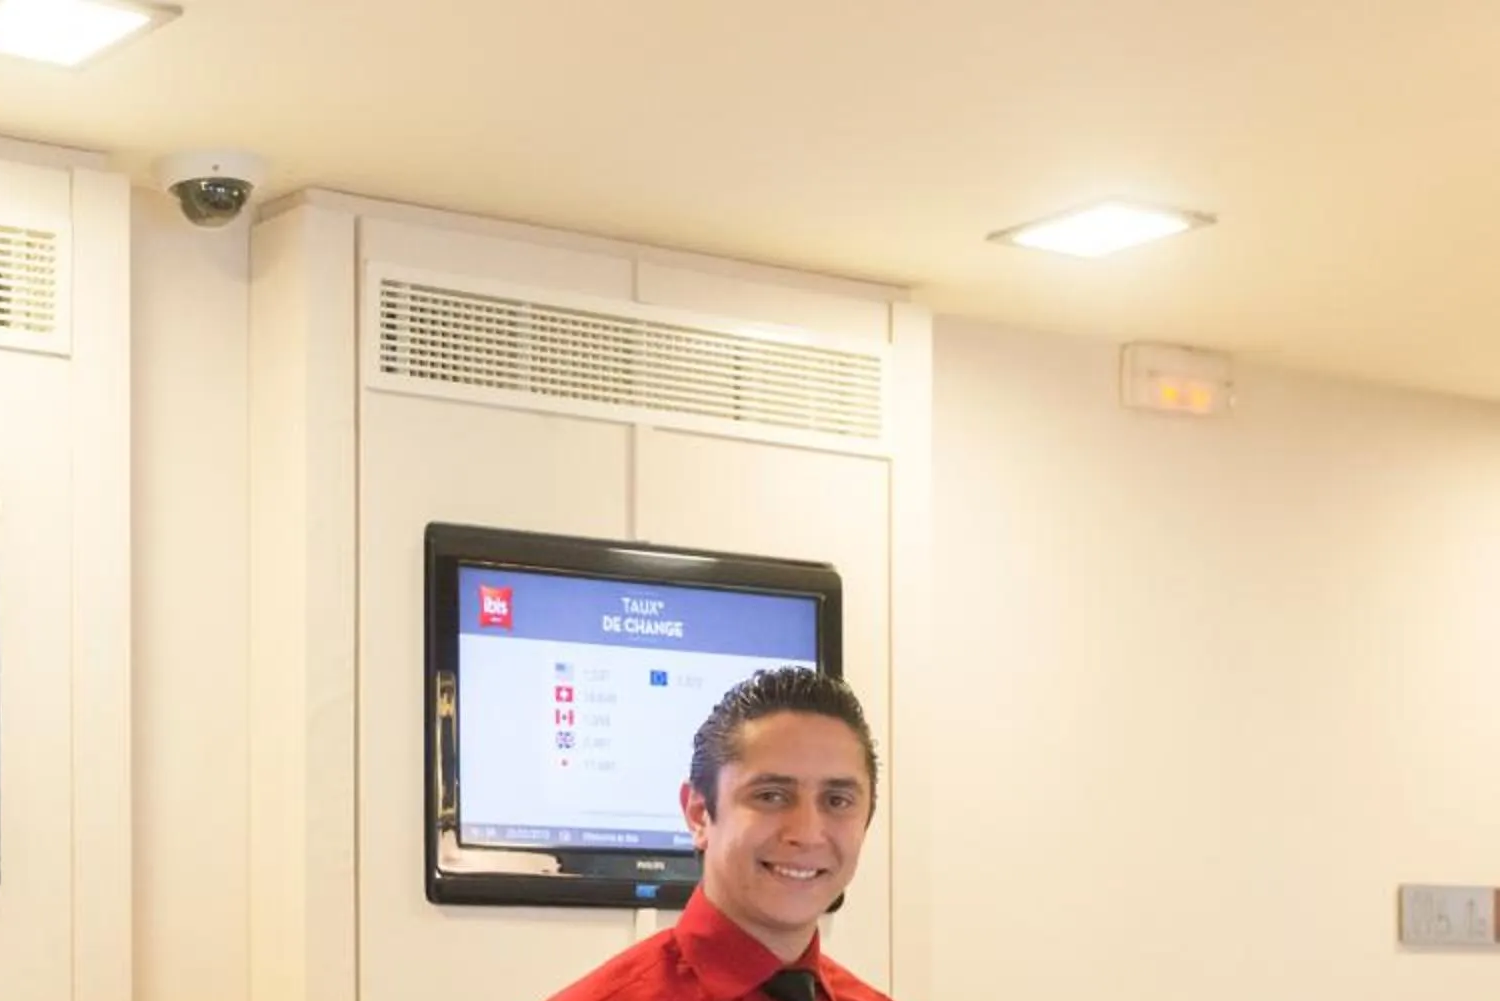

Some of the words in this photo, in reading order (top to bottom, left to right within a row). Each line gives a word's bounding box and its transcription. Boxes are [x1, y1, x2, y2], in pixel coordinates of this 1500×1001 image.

[483, 595, 508, 616] ibis
[602, 615, 621, 632] DE
[623, 617, 683, 638] CHANGE
